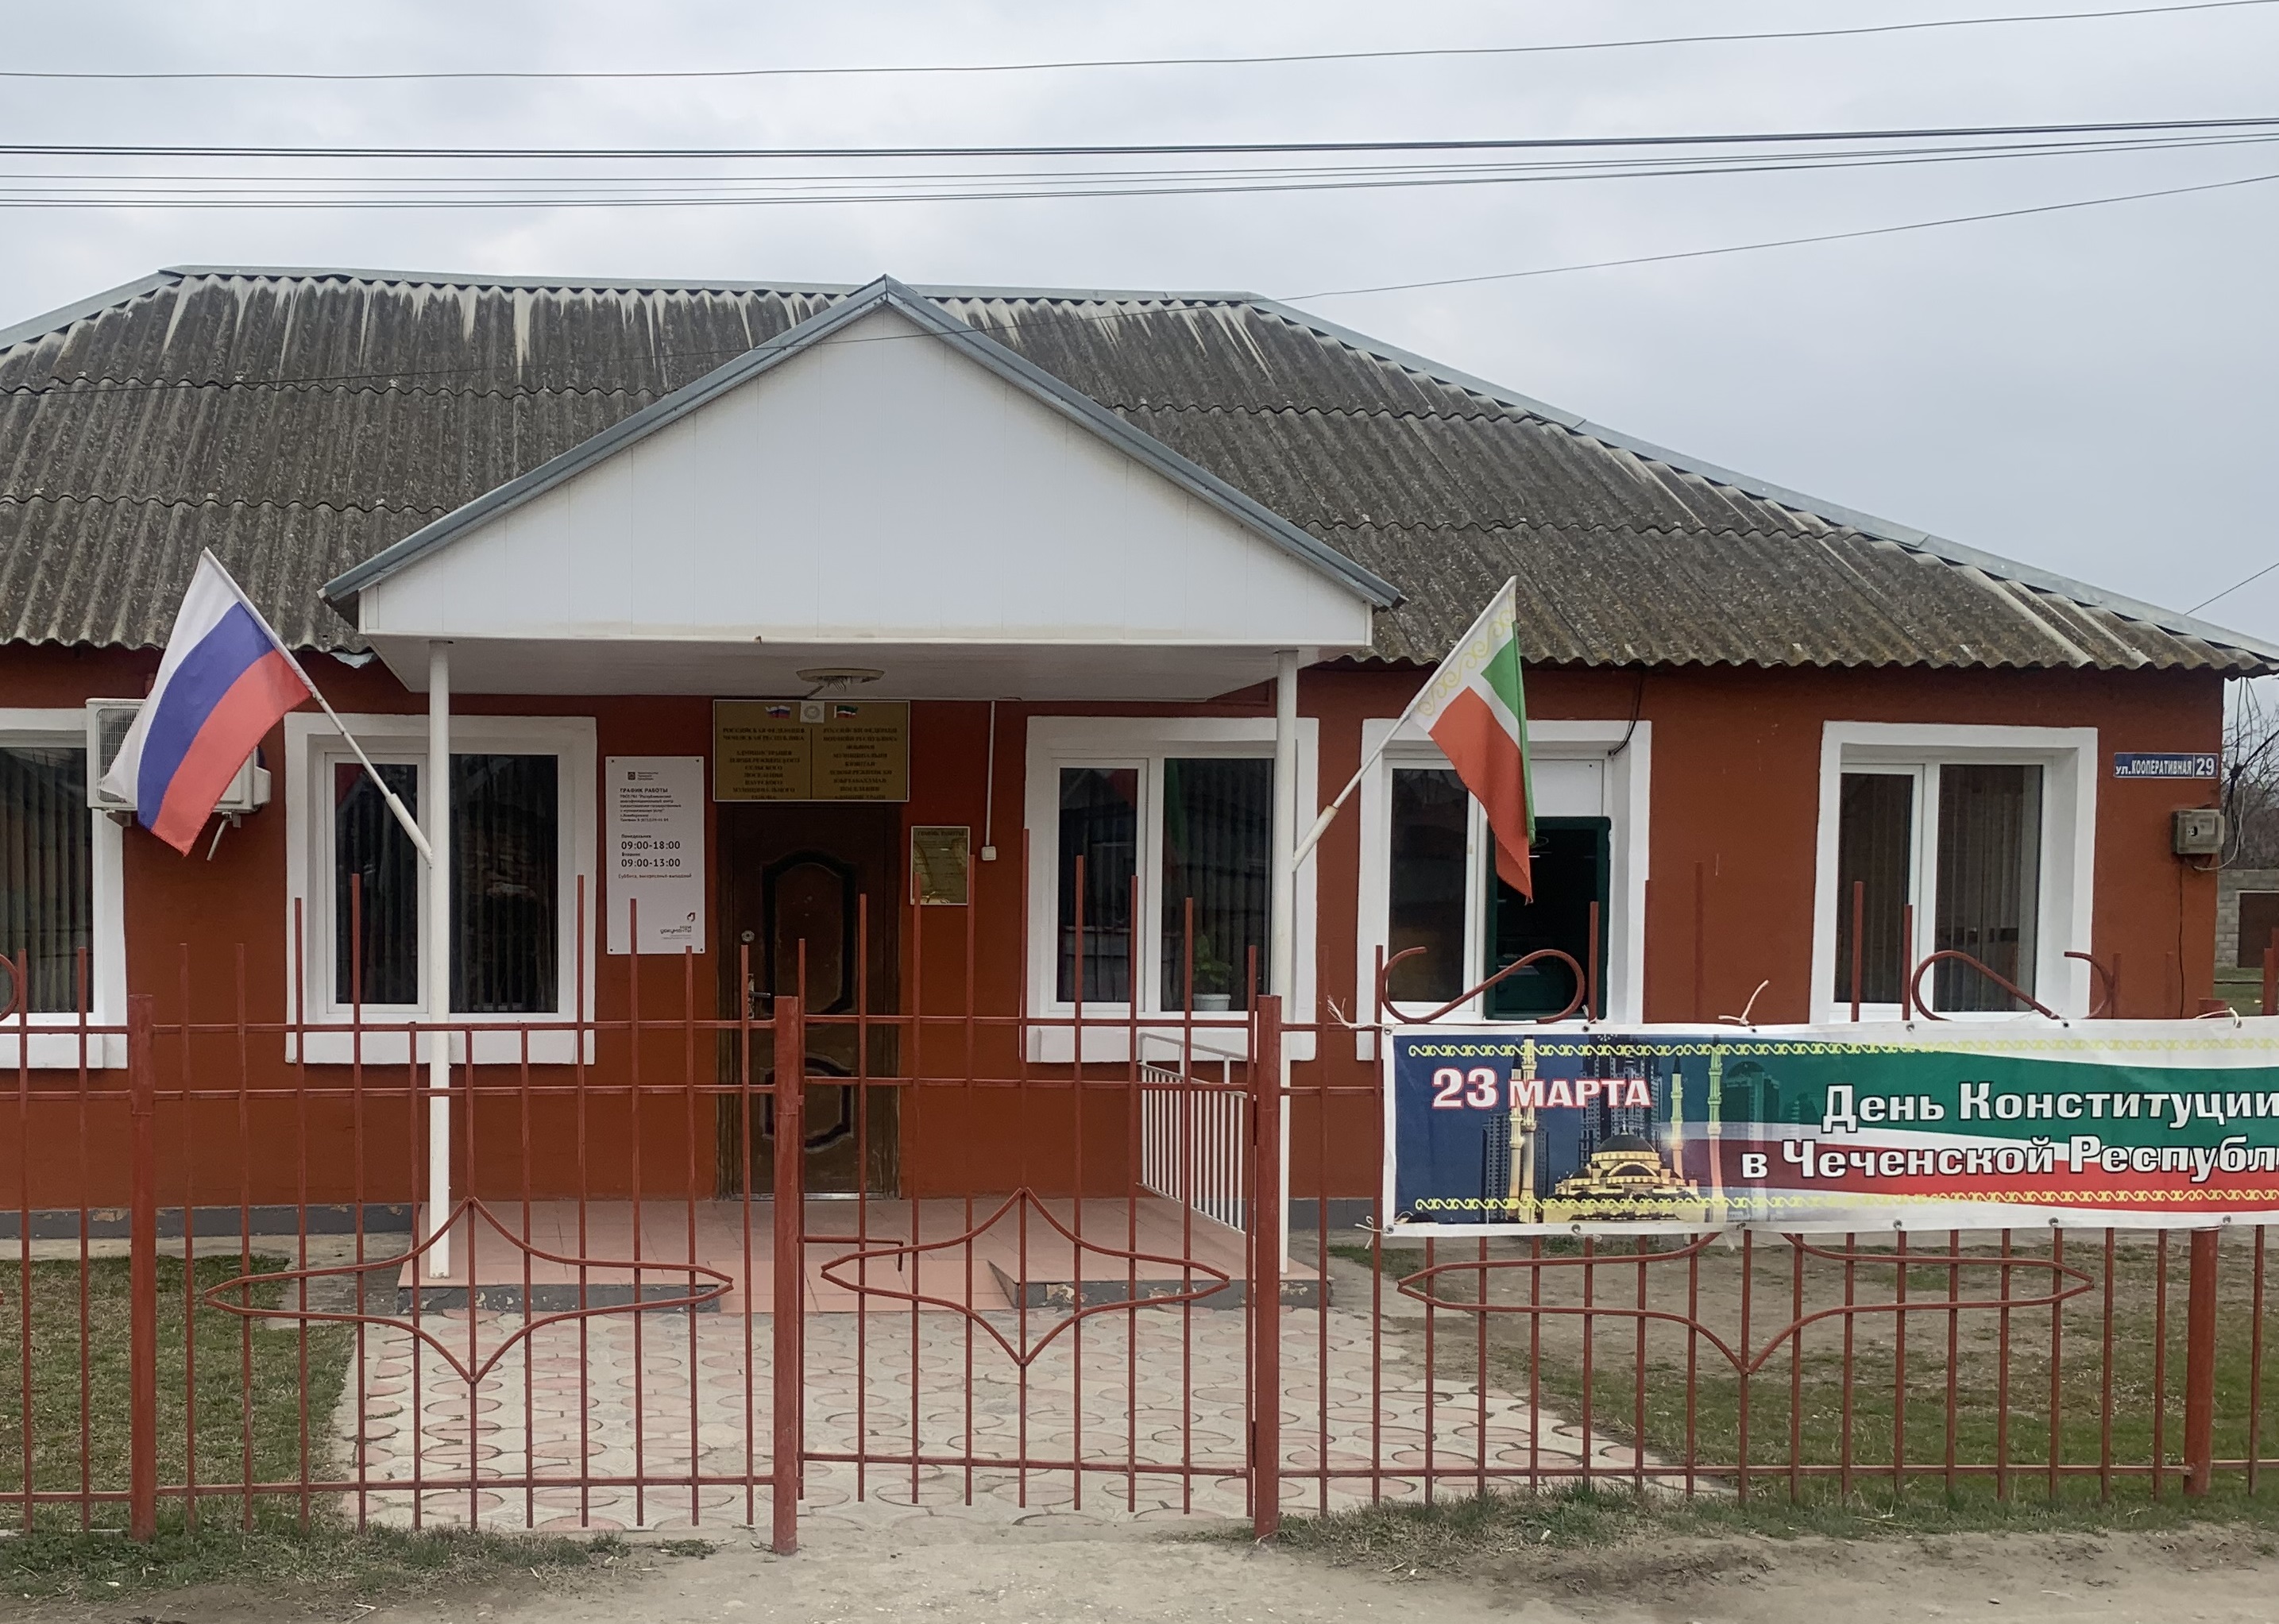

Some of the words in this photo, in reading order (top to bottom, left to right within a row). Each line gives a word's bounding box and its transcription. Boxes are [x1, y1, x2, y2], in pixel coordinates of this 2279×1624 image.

[2196, 757, 2215, 775] 29
[621, 841, 681, 850] 09:00-18:00
[621, 858, 681, 867] 09:00-13:00
[1432, 1066, 1498, 1109] 23
[1509, 1078, 1652, 1108] МАРТА
[1821, 1083, 1945, 1133] День
[1959, 1081, 2279, 1129] Конституции
[1741, 1152, 1768, 1178] в
[1783, 1136, 2055, 1178] Чеченской
[2069, 1133, 2279, 1183] Республ
